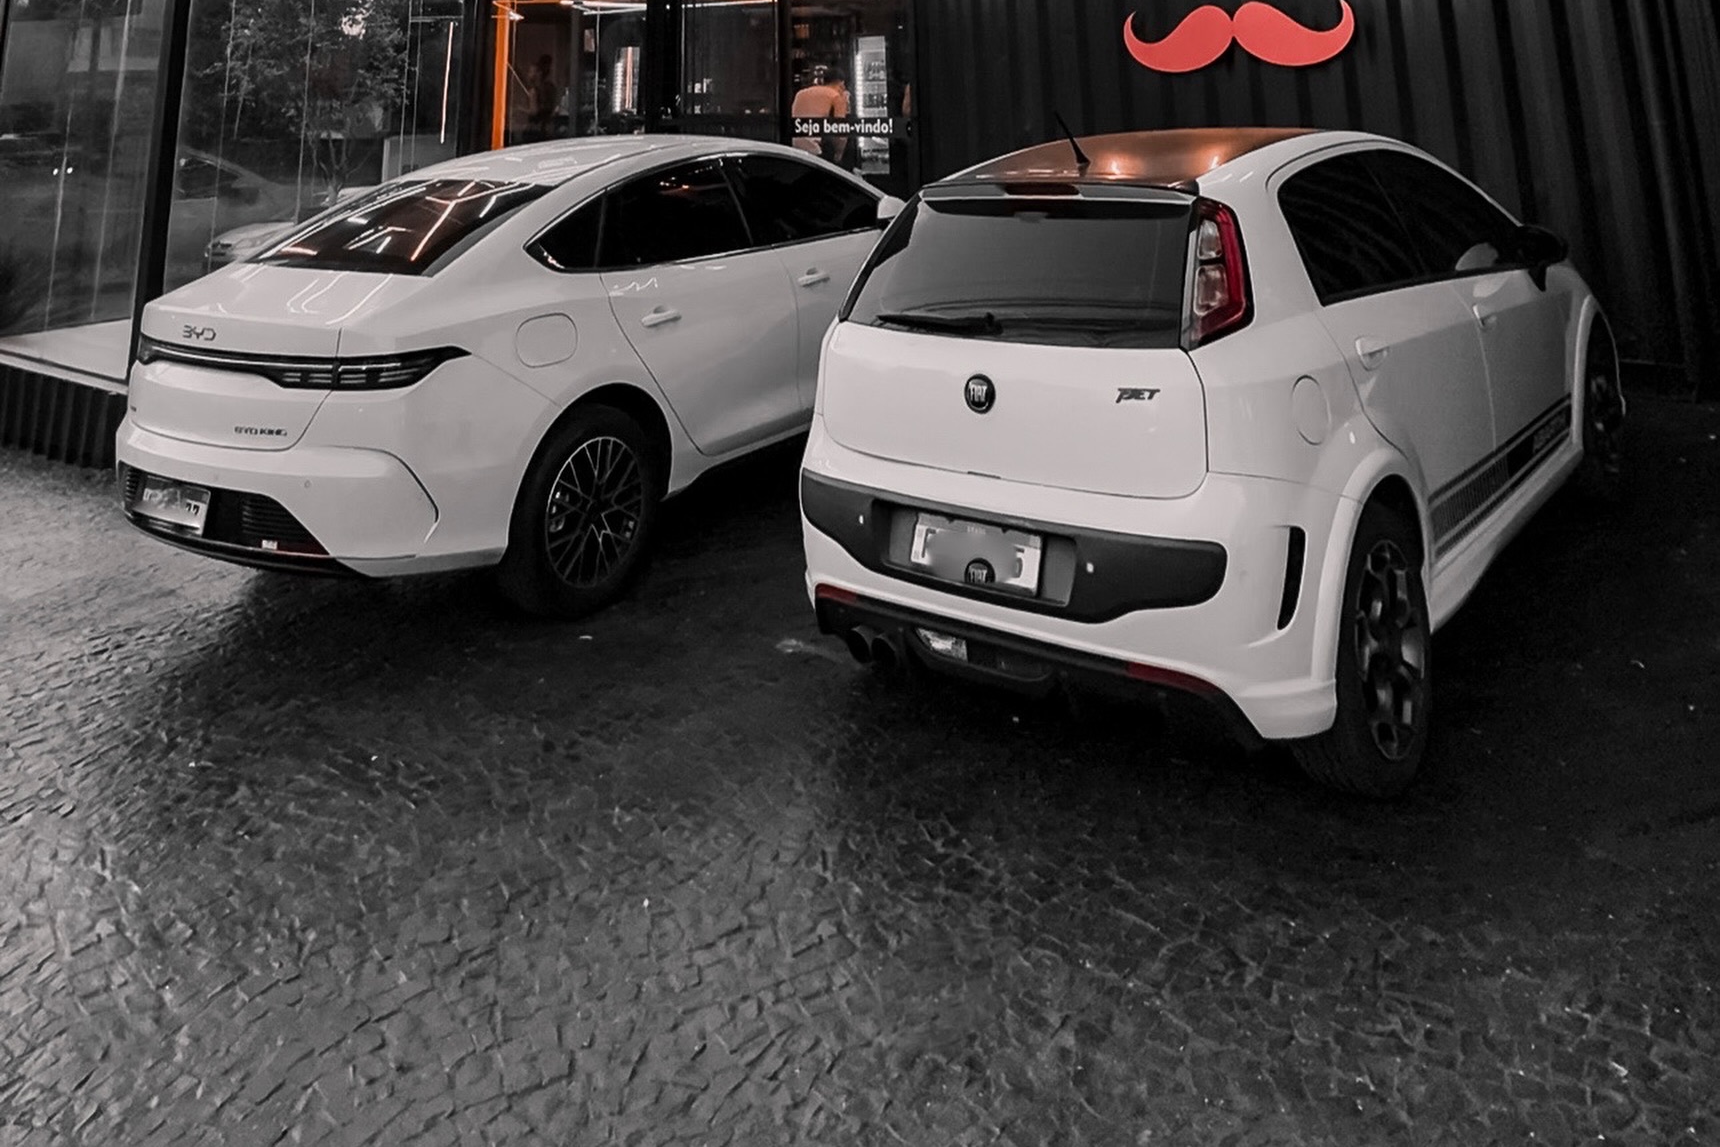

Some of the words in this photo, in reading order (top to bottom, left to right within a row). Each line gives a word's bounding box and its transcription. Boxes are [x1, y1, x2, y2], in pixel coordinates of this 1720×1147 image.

[795, 118, 820, 136] Seja
[823, 118, 893, 134] bem-vindo!
[182, 324, 217, 342] BYD
